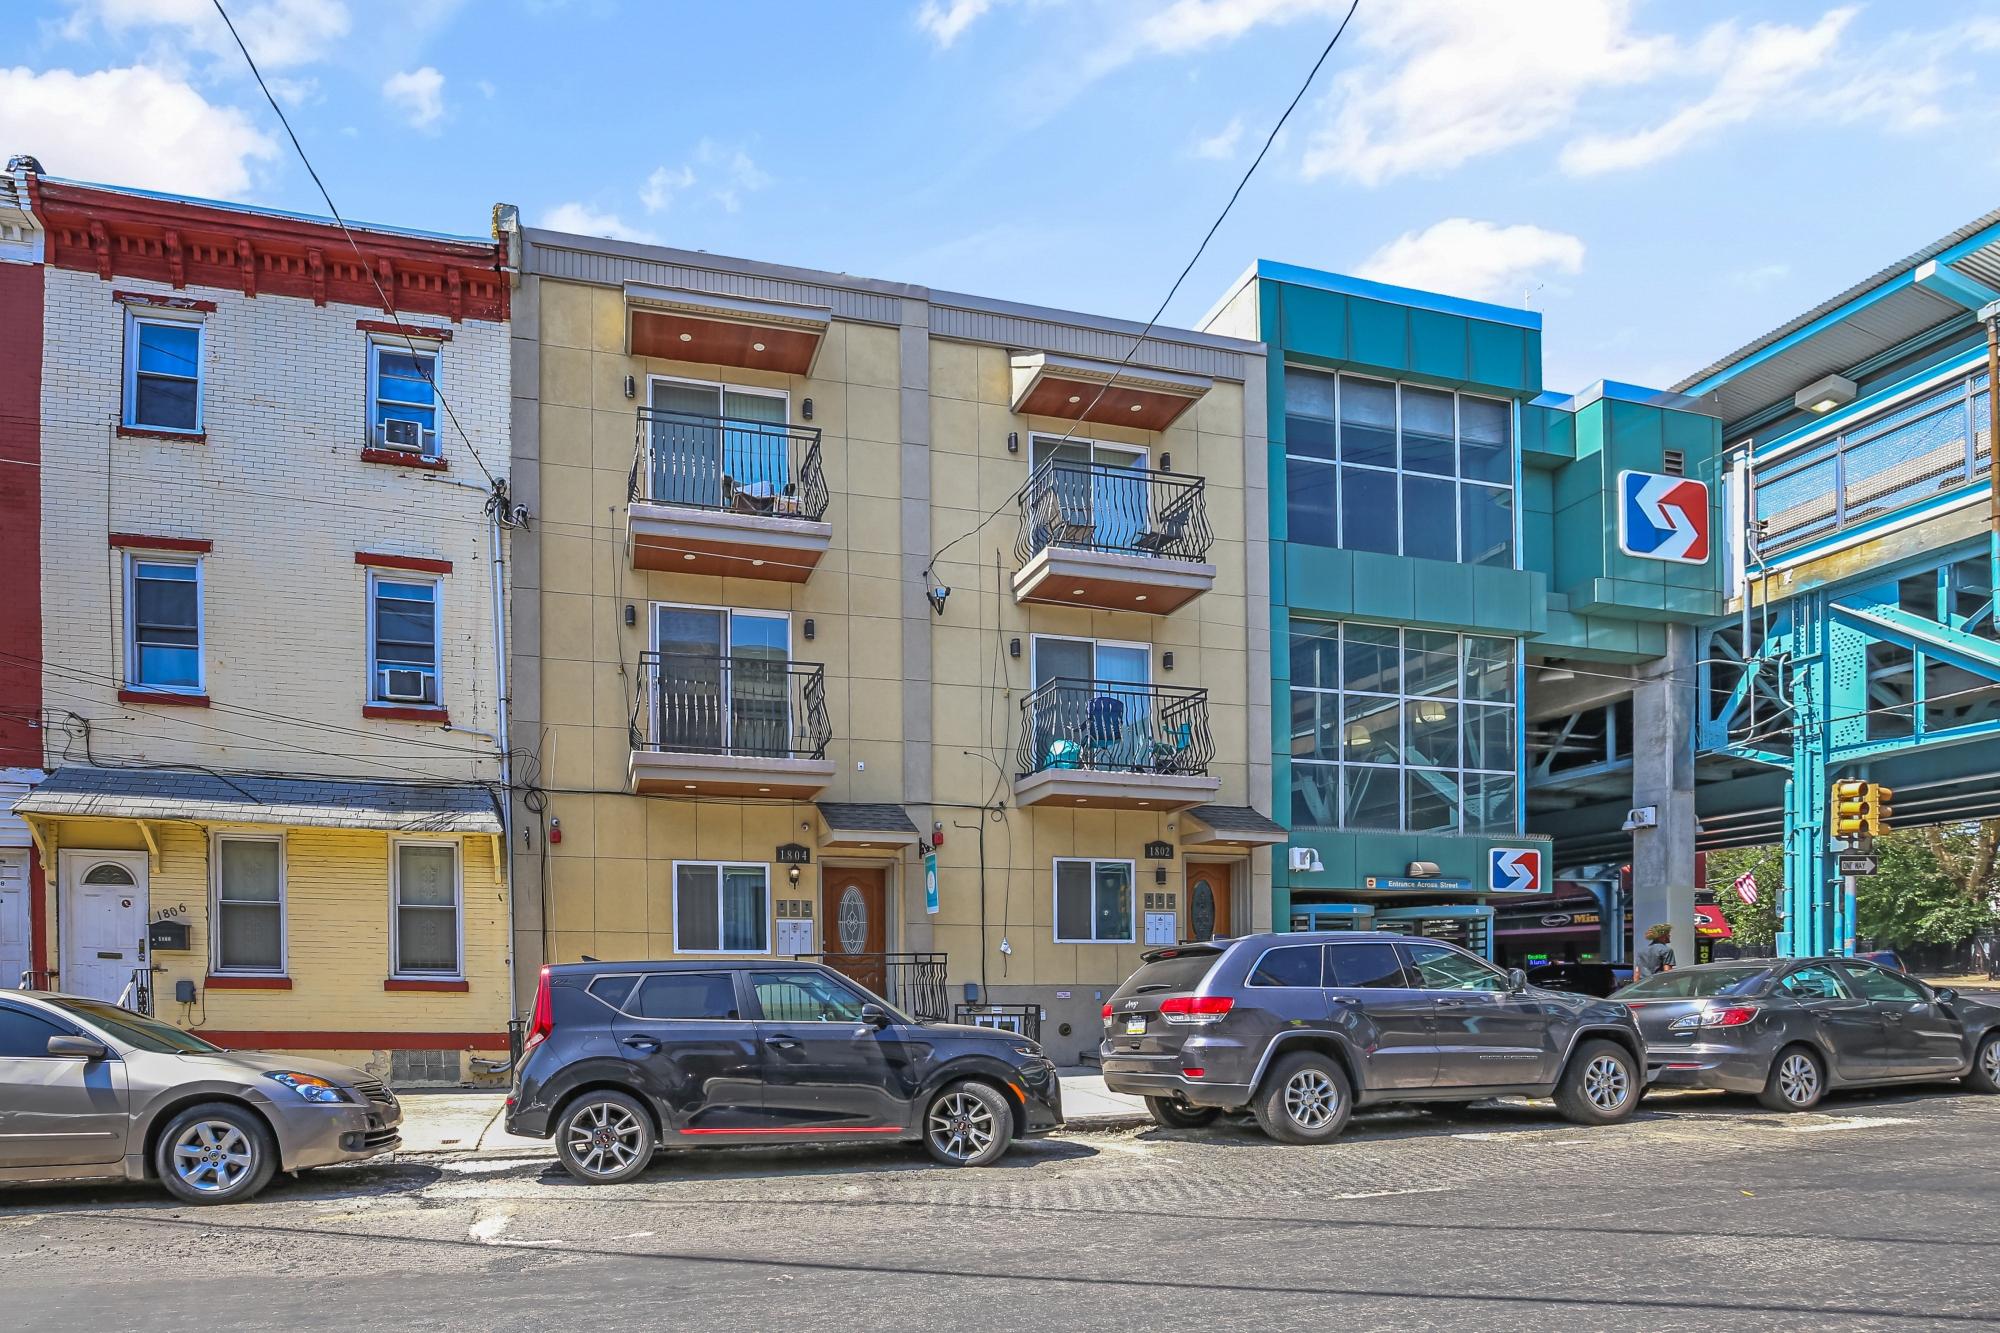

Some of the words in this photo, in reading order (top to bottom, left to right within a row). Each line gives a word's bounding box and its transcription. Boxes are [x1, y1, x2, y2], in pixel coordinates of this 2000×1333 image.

[780, 849, 807, 861] 1804
[1149, 846, 1170, 857] 1802
[1854, 861, 1866, 870] WAY
[1388, 880, 1415, 888] Entrance
[1417, 880, 1438, 888] Across
[1440, 881, 1458, 889] Street
[157, 902, 187, 920] 1806
[1573, 913, 1600, 924] Min
